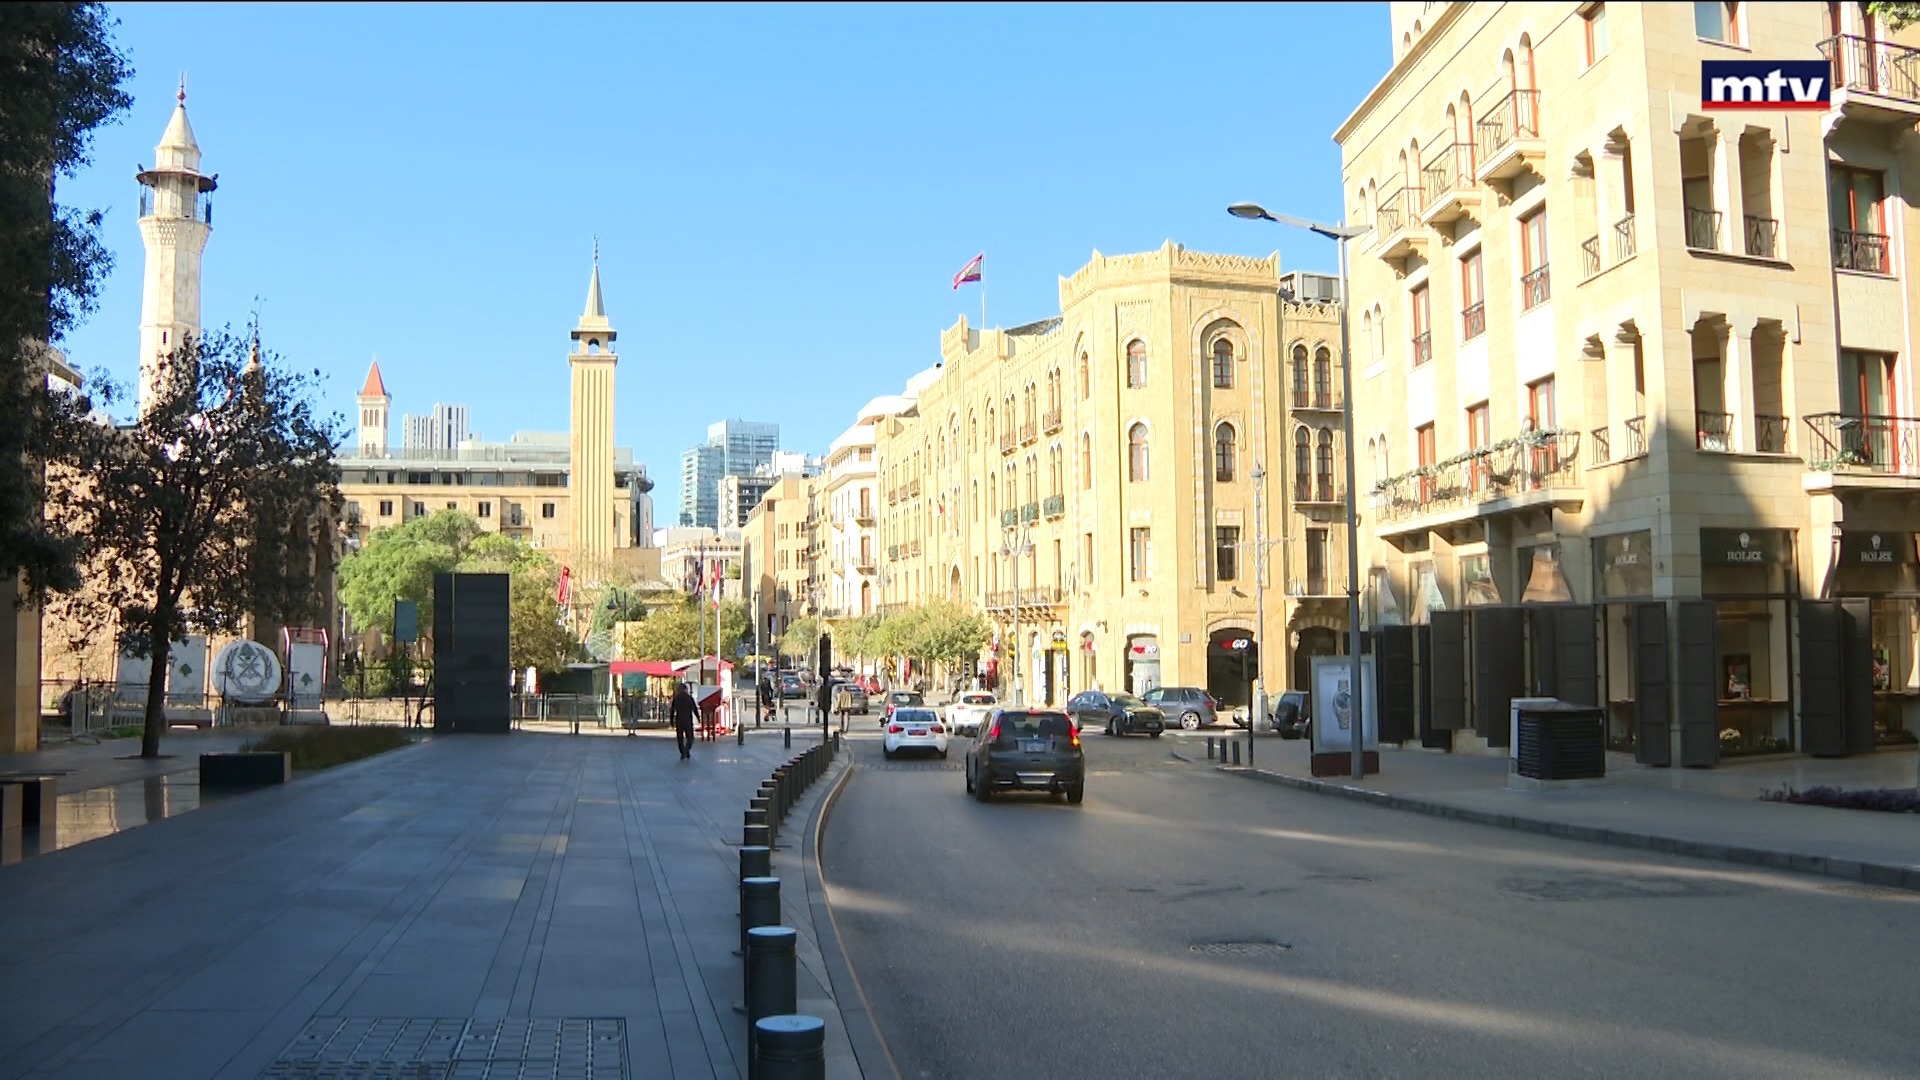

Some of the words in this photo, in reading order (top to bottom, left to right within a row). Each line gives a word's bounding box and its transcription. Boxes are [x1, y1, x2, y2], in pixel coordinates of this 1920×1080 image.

[1727, 551, 1762, 562] ROLEX
[1861, 551, 1892, 562] ROLEX
[1232, 639, 1248, 649] GO
